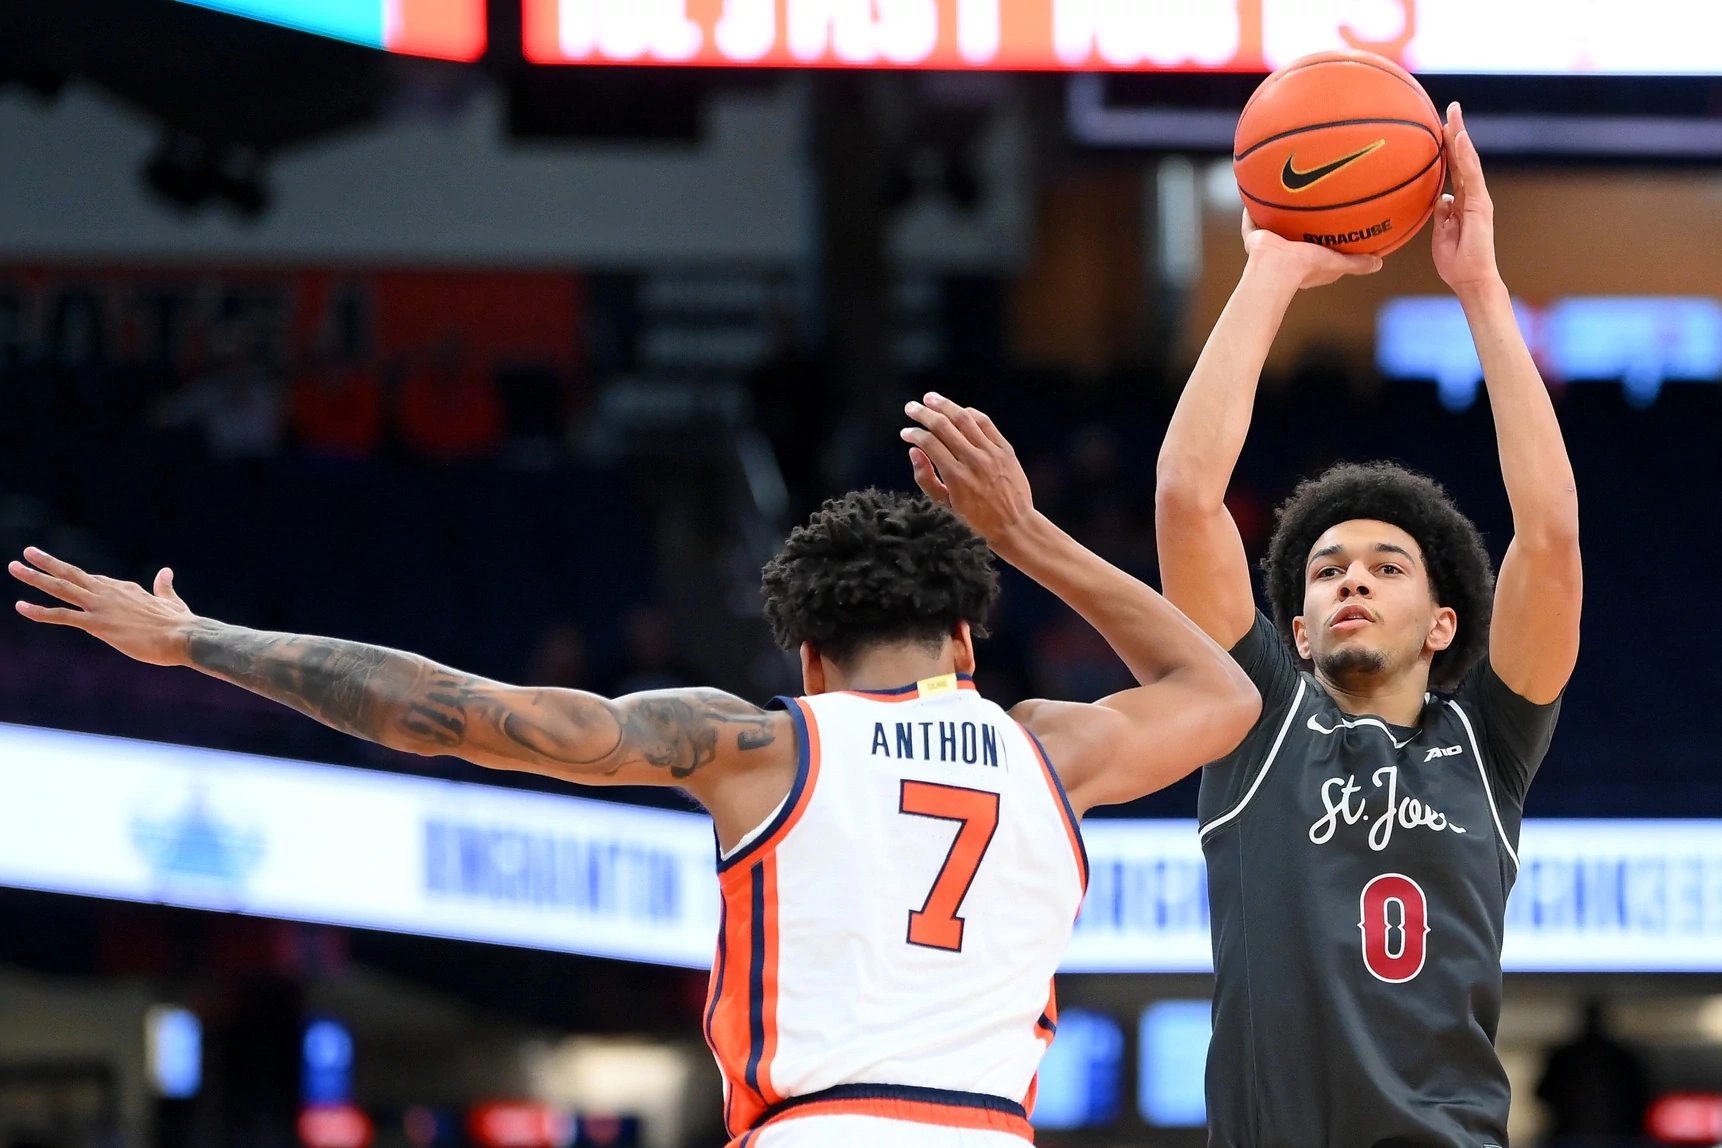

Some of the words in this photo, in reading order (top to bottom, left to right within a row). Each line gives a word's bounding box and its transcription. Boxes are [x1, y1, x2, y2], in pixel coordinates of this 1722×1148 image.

[1303, 218, 1393, 246] SYRACUSE
[871, 721, 1008, 773] ANTHON
[1308, 774, 1369, 845] St.
[898, 779, 1001, 953] 7
[1357, 872, 1431, 984] 0
